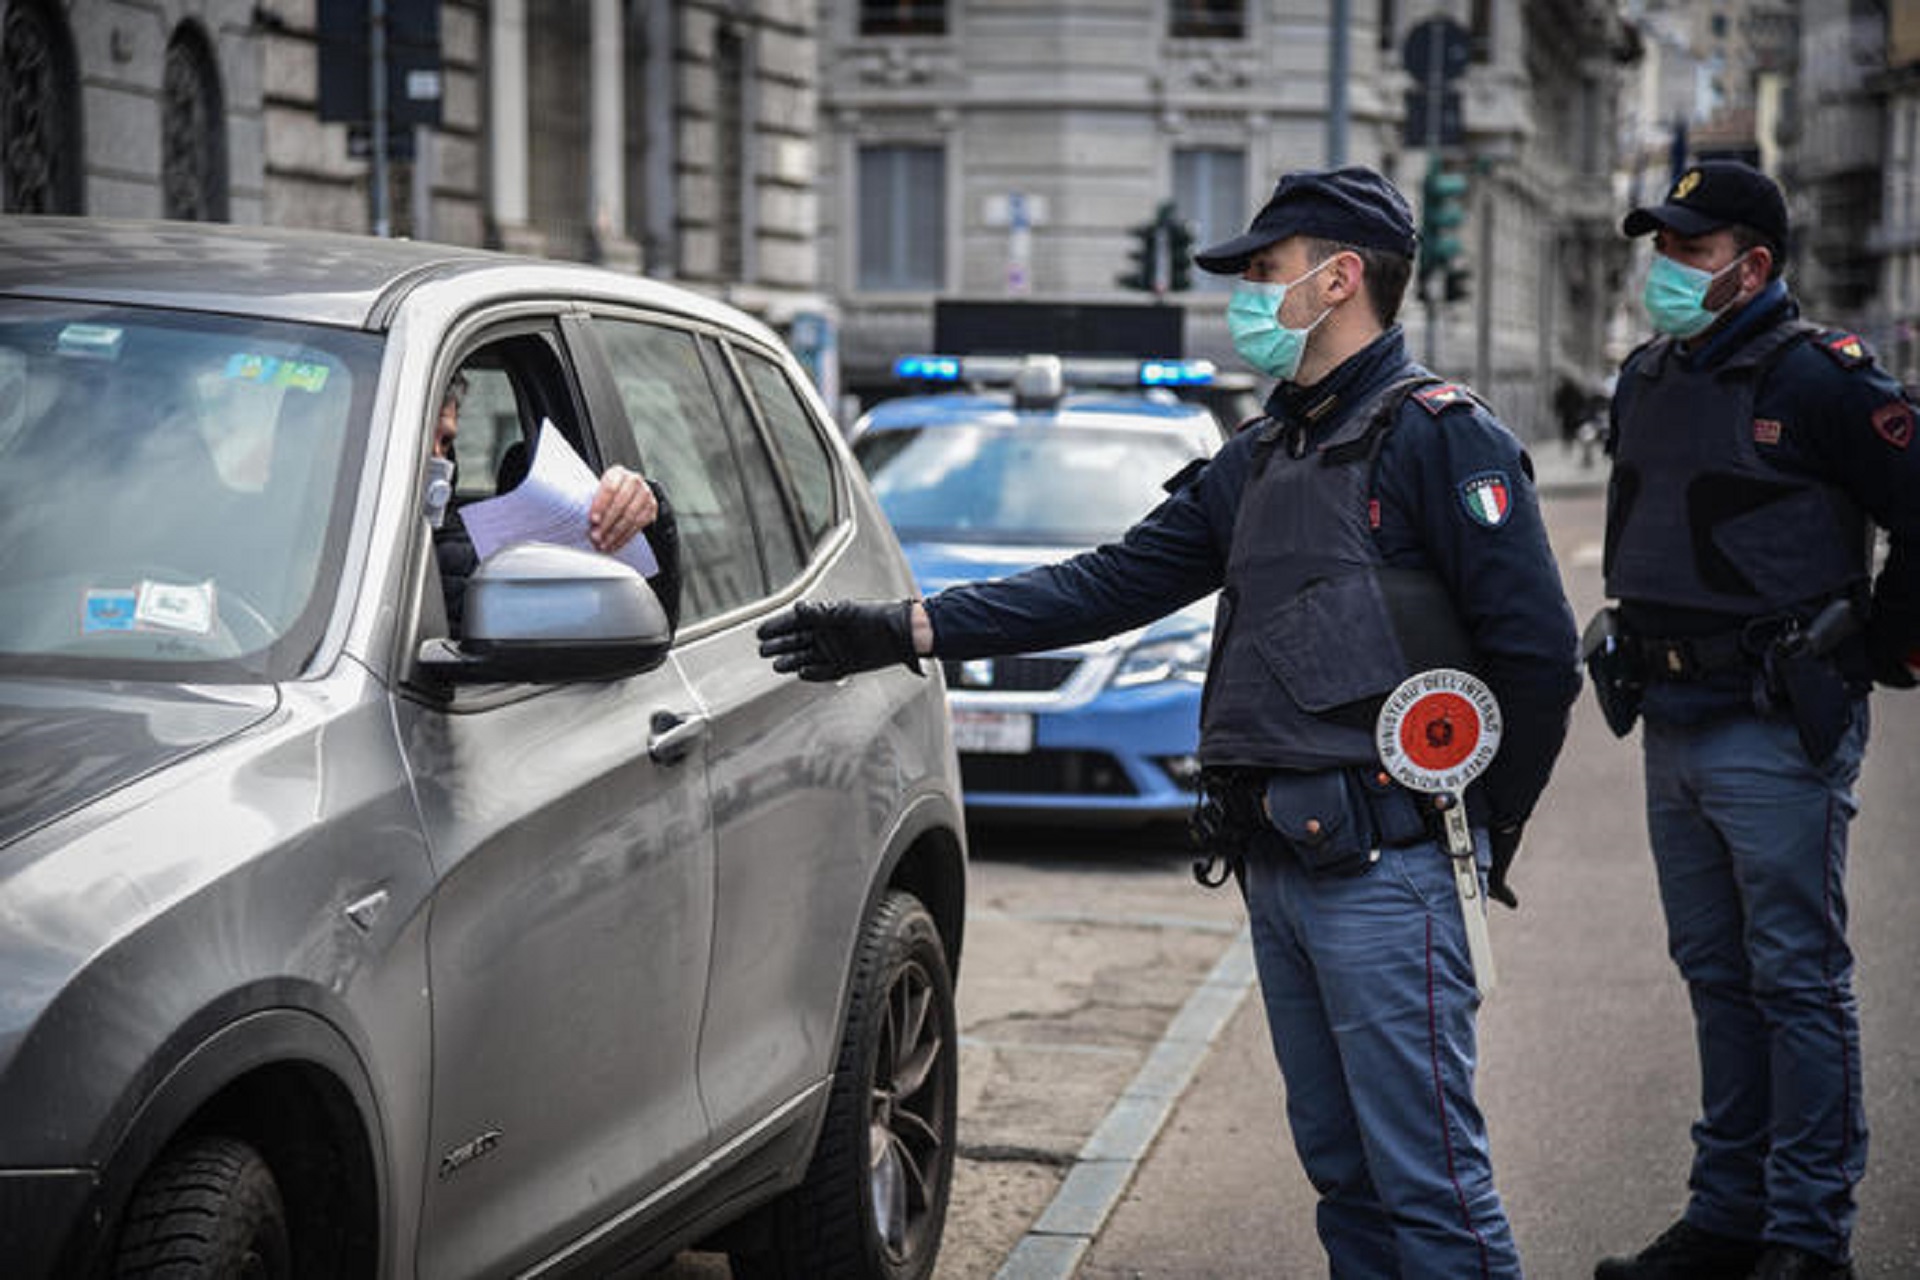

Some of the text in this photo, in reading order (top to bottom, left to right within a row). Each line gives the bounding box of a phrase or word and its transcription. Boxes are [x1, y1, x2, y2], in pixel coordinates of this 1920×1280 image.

[1466, 478, 1501, 492] ITALIA
[1382, 684, 1419, 756] MINISTERO
[1399, 766, 1441, 788] POLIZIA
[1464, 745, 1493, 777] STATO
